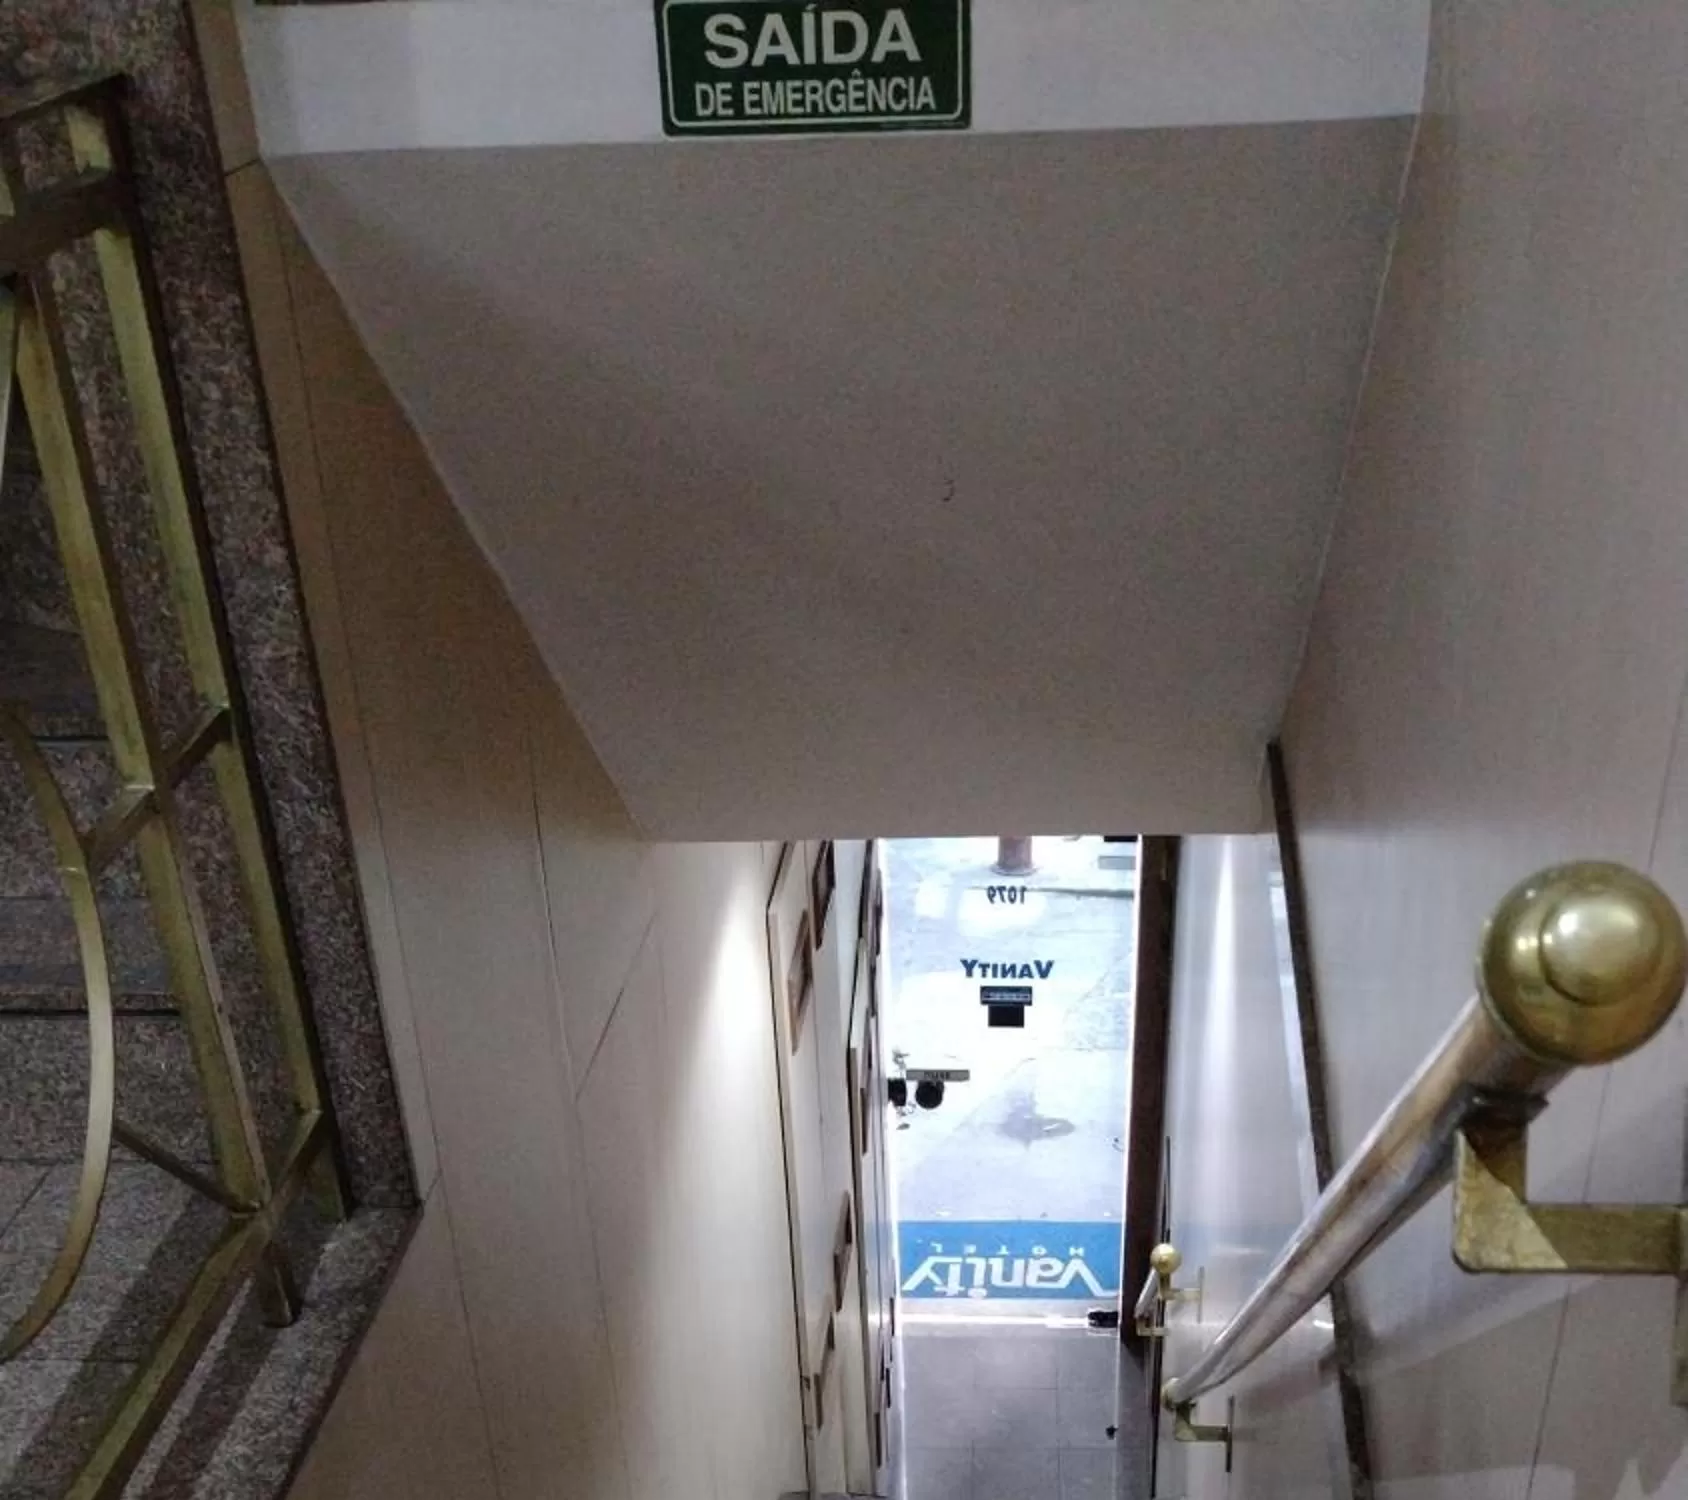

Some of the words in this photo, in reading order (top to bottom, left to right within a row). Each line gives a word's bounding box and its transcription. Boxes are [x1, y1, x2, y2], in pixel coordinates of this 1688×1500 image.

[703, 3, 922, 69] SAÍDA
[695, 81, 734, 117] DE
[744, 68, 937, 115] EMERGÊNCIA
[930, 1242, 1085, 1257] HOTEL
